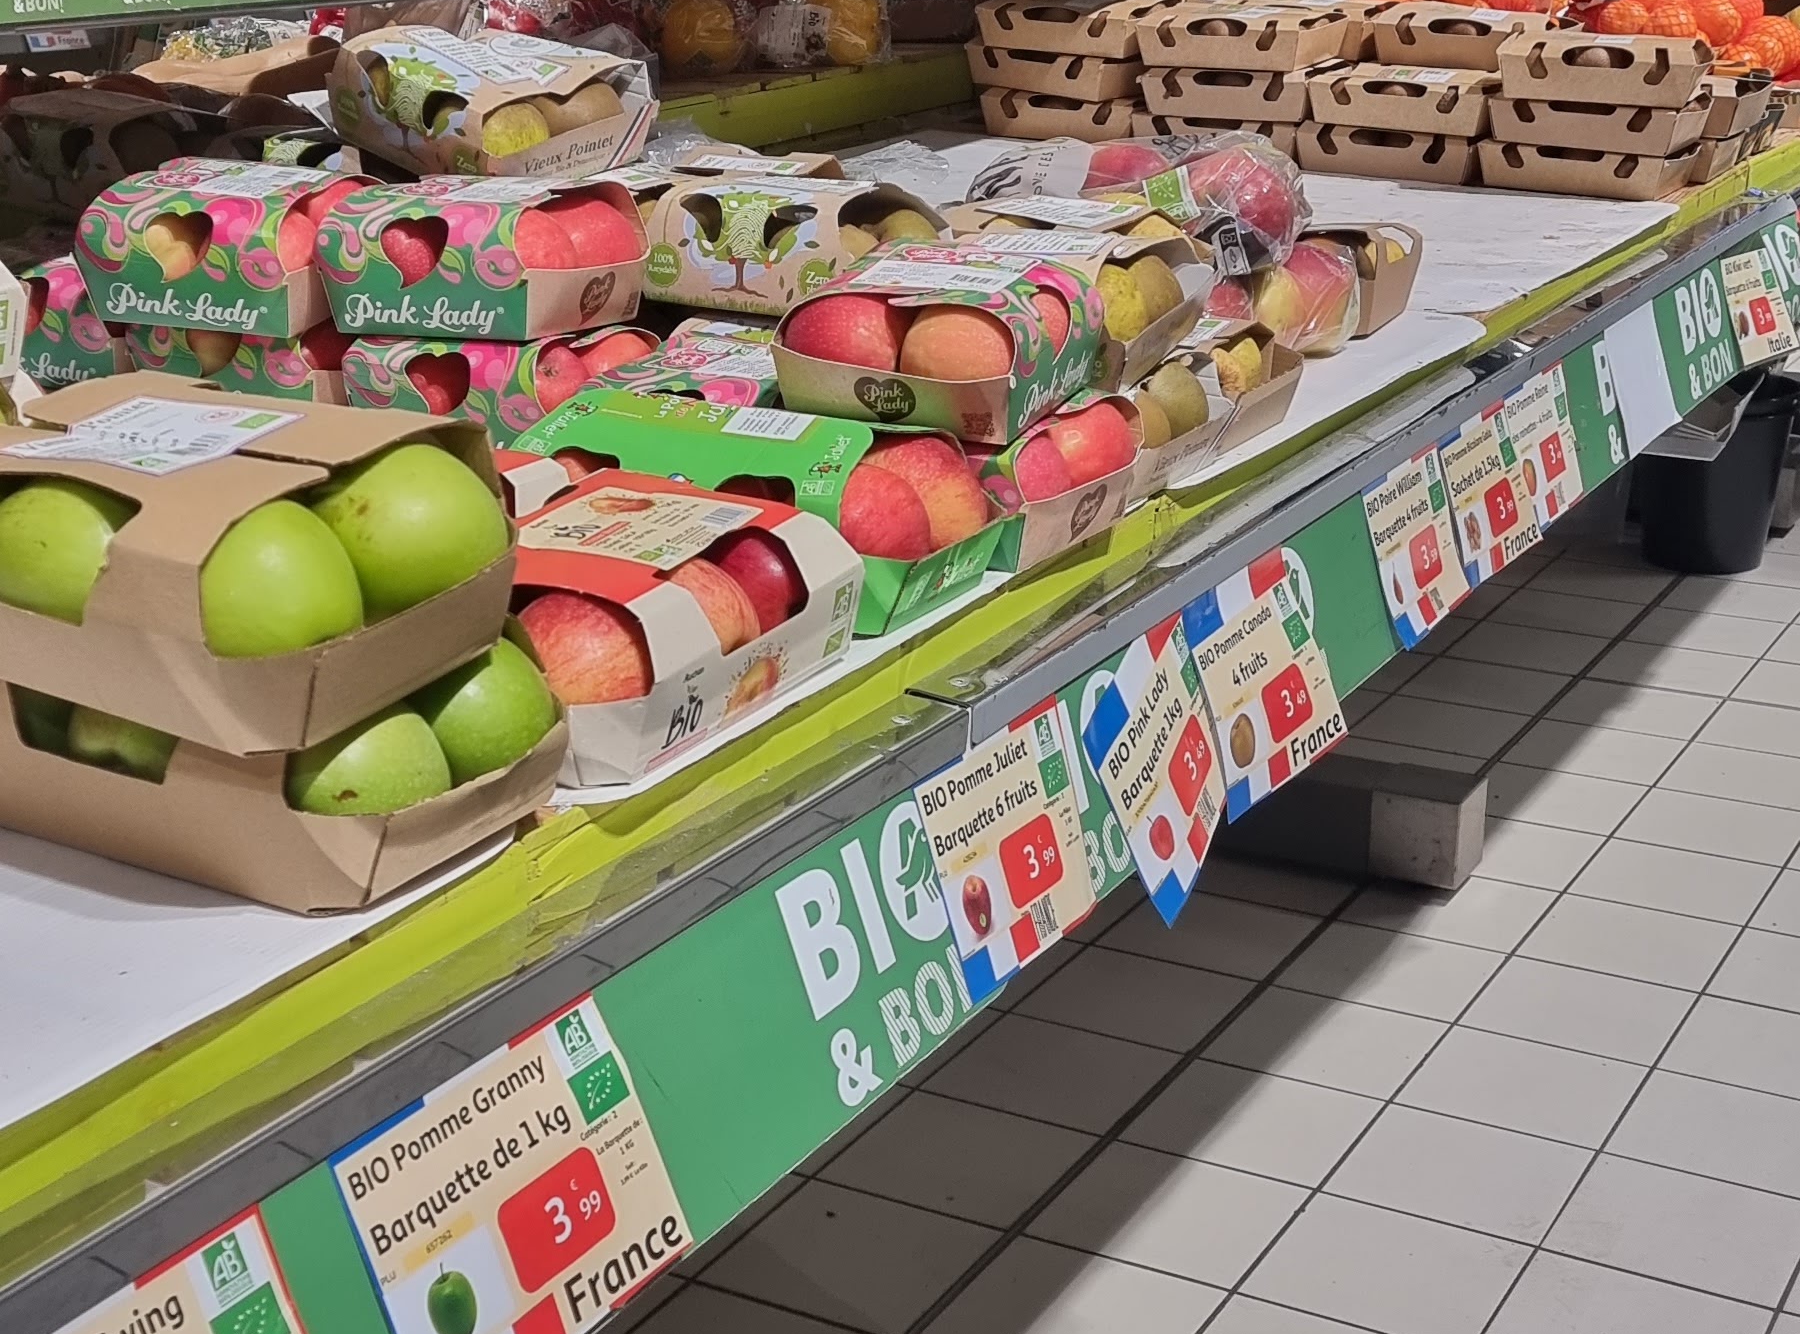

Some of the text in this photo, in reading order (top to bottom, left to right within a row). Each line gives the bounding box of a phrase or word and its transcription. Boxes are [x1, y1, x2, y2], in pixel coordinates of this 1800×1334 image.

[524, 152, 563, 175] Vieux
[566, 134, 614, 160] Pointet
[106, 282, 182, 316] Pink
[345, 293, 418, 327] Pink
[1674, 268, 1722, 356] BIO
[1756, 308, 1765, 325] 3
[1767, 331, 1793, 353] Italie
[864, 383, 904, 402] Pink
[872, 397, 909, 413] Lady
[1548, 444, 1556, 465] 3
[1379, 487, 1397, 509] Poire
[1395, 470, 1422, 497] William
[1451, 471, 1474, 498] Sachet
[1474, 465, 1484, 481] de
[1373, 513, 1407, 547] Barquette
[1410, 498, 1429, 520] fruits
[1496, 496, 1506, 520] 3
[1420, 544, 1430, 570] 3
[1503, 522, 1539, 560] France
[1198, 605, 1272, 671] BIO Pomme Canada
[1232, 649, 1268, 687] 4 fruits
[1280, 688, 1307, 718] 3 49
[1108, 668, 1169, 780] BIO Pink Lady
[1291, 712, 1343, 768] France
[1121, 697, 1182, 810] Barquette 1kg
[1184, 751, 1197, 782] 3
[922, 738, 1028, 816] BIO Pomme Juliet
[934, 779, 1037, 858] Barquette 6 fruits
[1023, 845, 1055, 879] 3 99
[776, 800, 950, 1021] BIO
[564, 1022, 588, 1055] AB
[830, 1028, 883, 1107] &
[347, 1156, 390, 1201] BIO
[391, 1105, 470, 1170] Pomme
[472, 1054, 546, 1114] Granny
[603, 1126, 632, 1151] Barquette
[369, 1103, 571, 1256] Barquette de 1 kg
[544, 1190, 602, 1244] 3 99
[213, 1250, 243, 1291] AB
[563, 1215, 683, 1324] France
